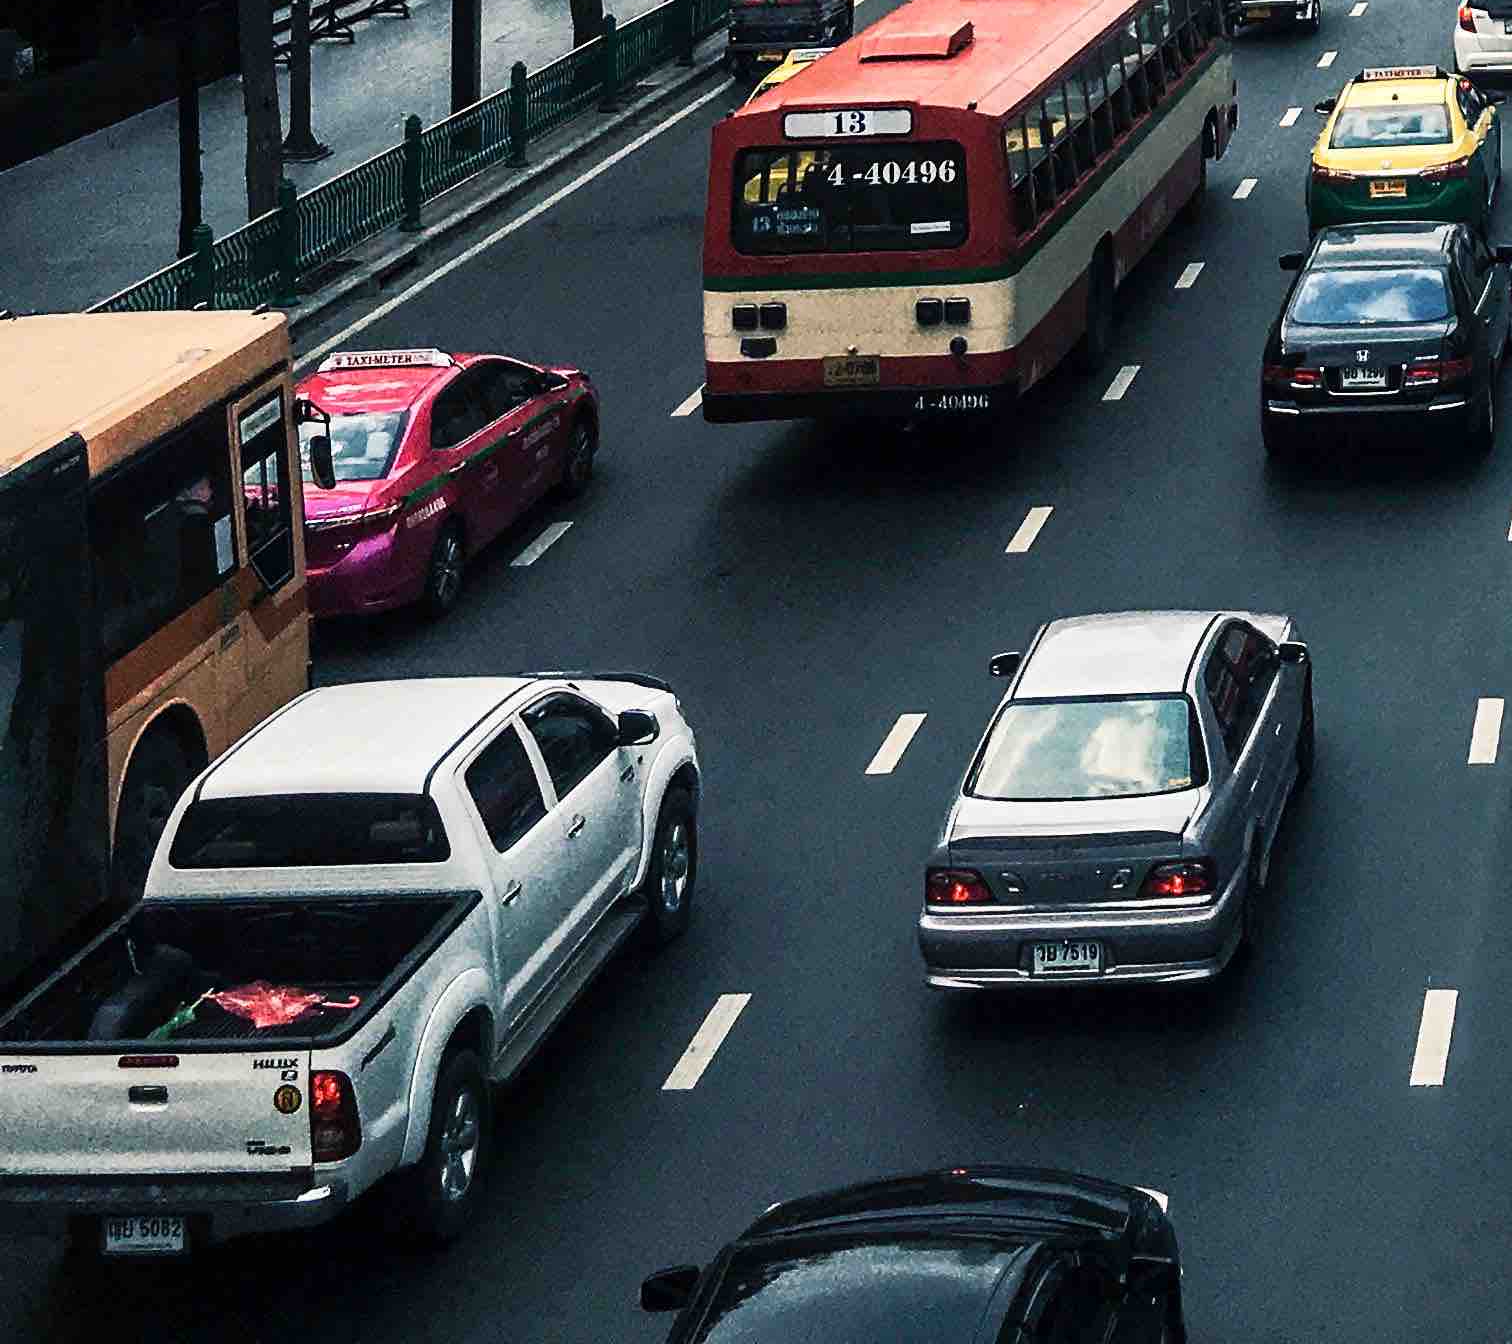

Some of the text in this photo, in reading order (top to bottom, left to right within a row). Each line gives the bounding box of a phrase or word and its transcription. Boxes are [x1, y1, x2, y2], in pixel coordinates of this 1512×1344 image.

[834, 112, 866, 134] 13
[1063, 943, 1097, 960] 7519
[253, 1058, 299, 1069] HILUX
